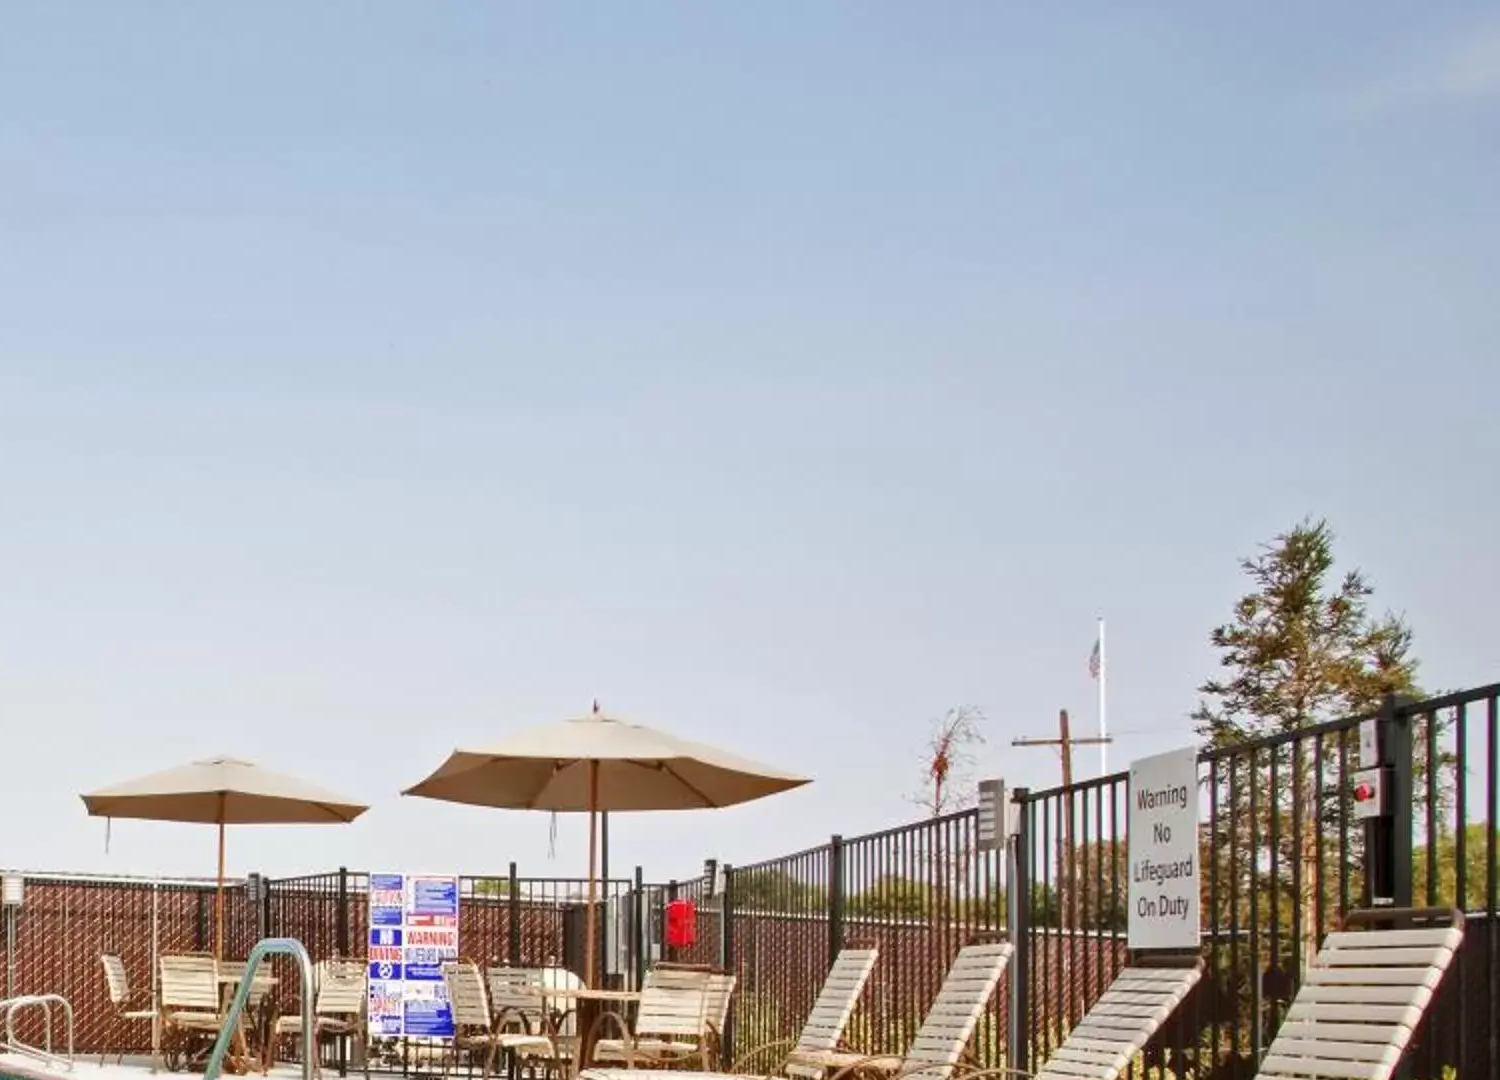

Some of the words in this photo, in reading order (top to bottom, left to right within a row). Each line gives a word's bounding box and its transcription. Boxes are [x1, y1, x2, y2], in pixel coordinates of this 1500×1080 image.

[1137, 784, 1187, 810] Warning
[1153, 823, 1172, 845] No
[1133, 853, 1193, 886] Lifeguard
[1137, 897, 1157, 918] On
[1158, 895, 1189, 920] Duty
